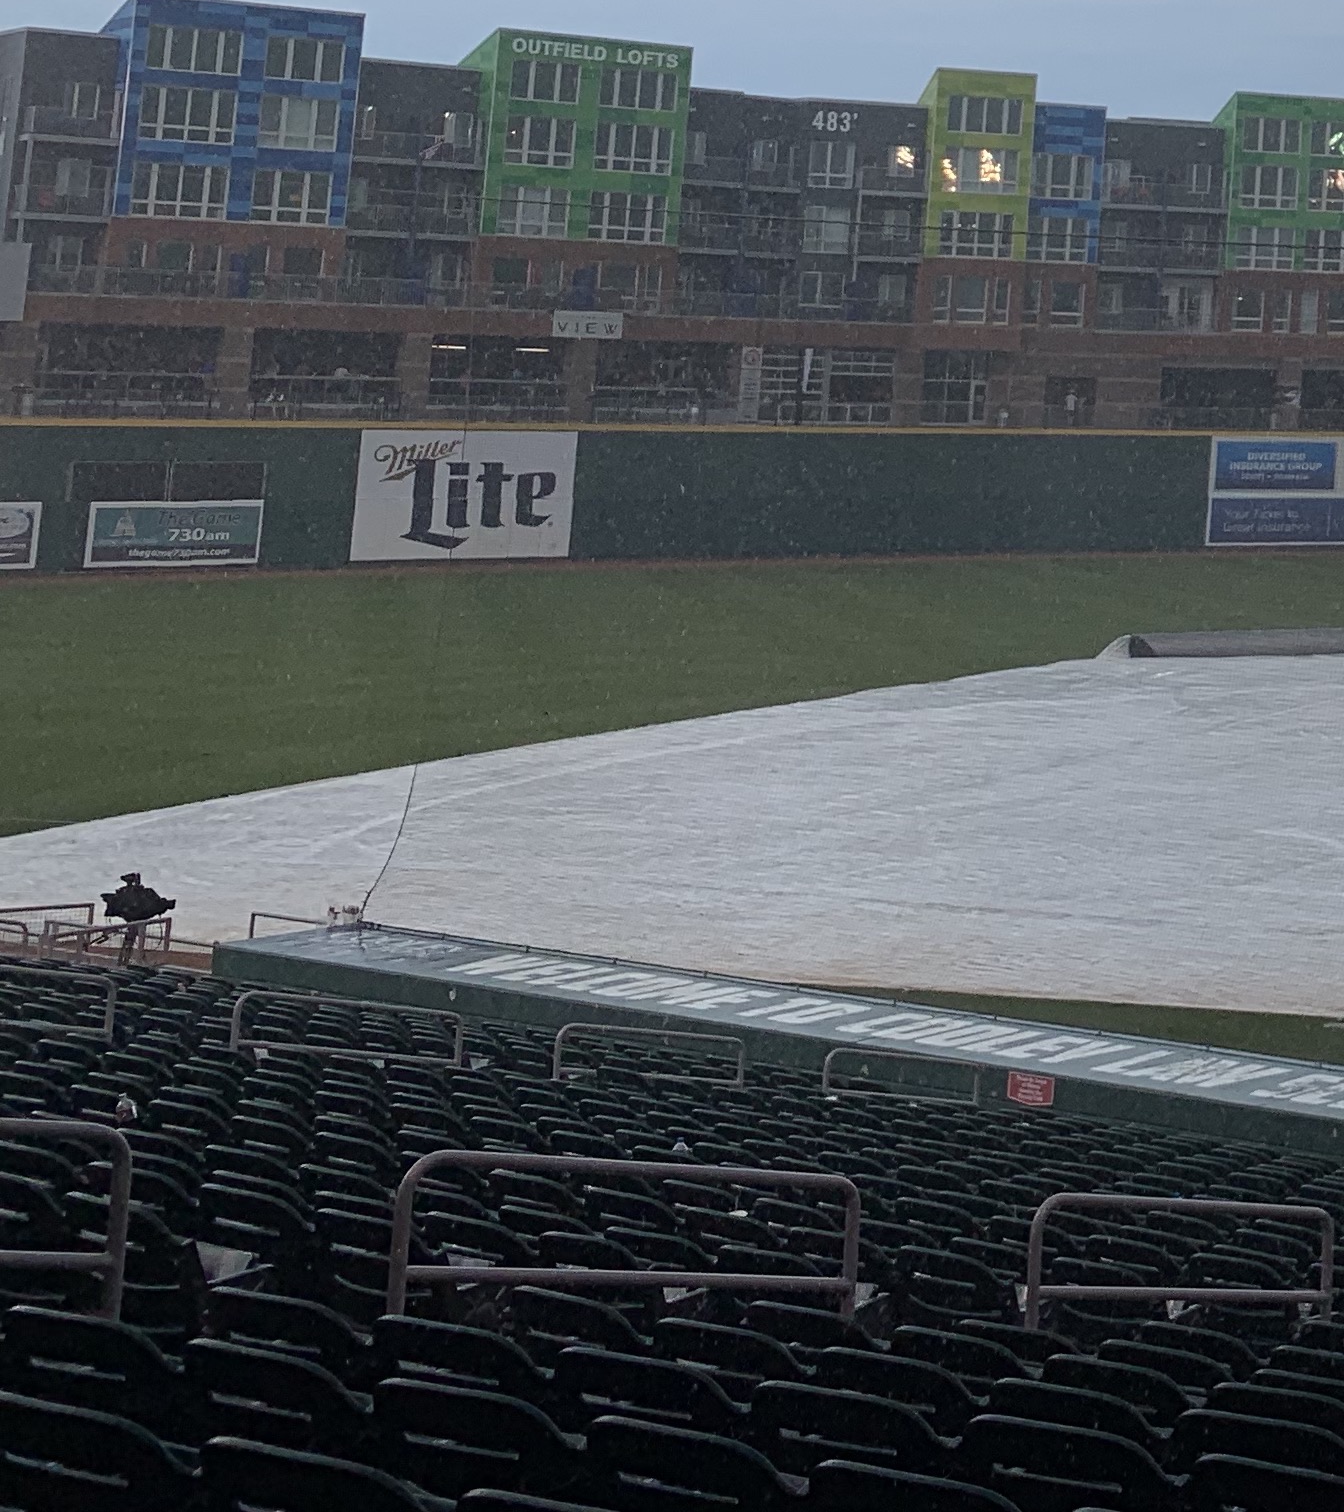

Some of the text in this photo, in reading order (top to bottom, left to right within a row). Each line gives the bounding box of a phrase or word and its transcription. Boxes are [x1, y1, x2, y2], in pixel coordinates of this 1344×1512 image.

[512, 38, 679, 68] OUTFIELD LOFTS
[811, 110, 859, 132] 483'
[558, 321, 618, 334] VIEW
[374, 440, 463, 481] Miller
[1229, 461, 1323, 471] INSURANCE GROUP
[1247, 452, 1307, 461] DIVERSIFIED
[400, 459, 557, 549] Lite
[158, 509, 241, 525] The Game
[168, 528, 230, 542] 730am
[446, 953, 780, 1010] WELCOME
[735, 997, 871, 1025] TO
[835, 1012, 1136, 1064] COOLEY
[1091, 1050, 1294, 1088] LAW
